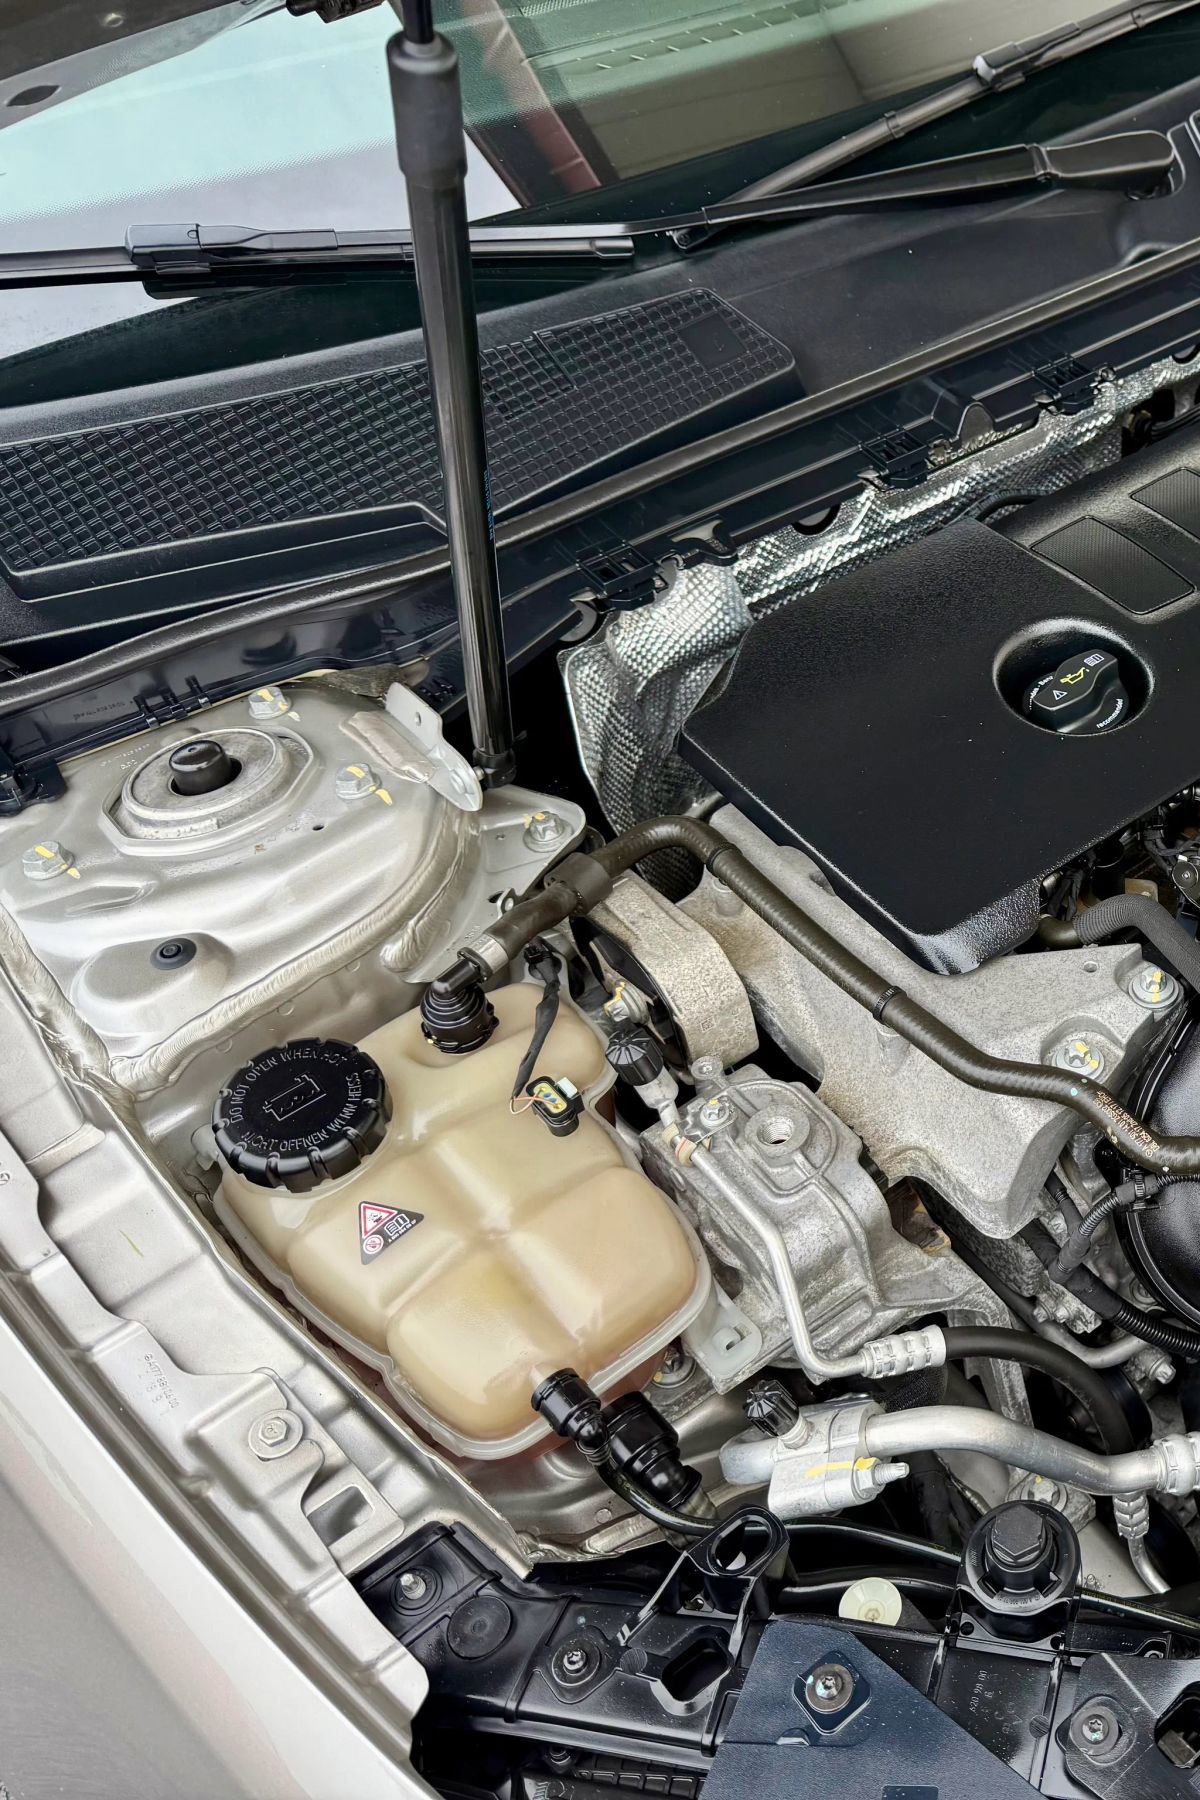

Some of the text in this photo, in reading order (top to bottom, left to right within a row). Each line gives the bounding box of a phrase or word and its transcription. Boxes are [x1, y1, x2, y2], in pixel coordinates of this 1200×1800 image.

[1096, 698, 1124, 729] recommended
[245, 1056, 279, 1082] OPEN
[231, 1083, 252, 1106] NOT
[230, 1106, 245, 1124] DO
